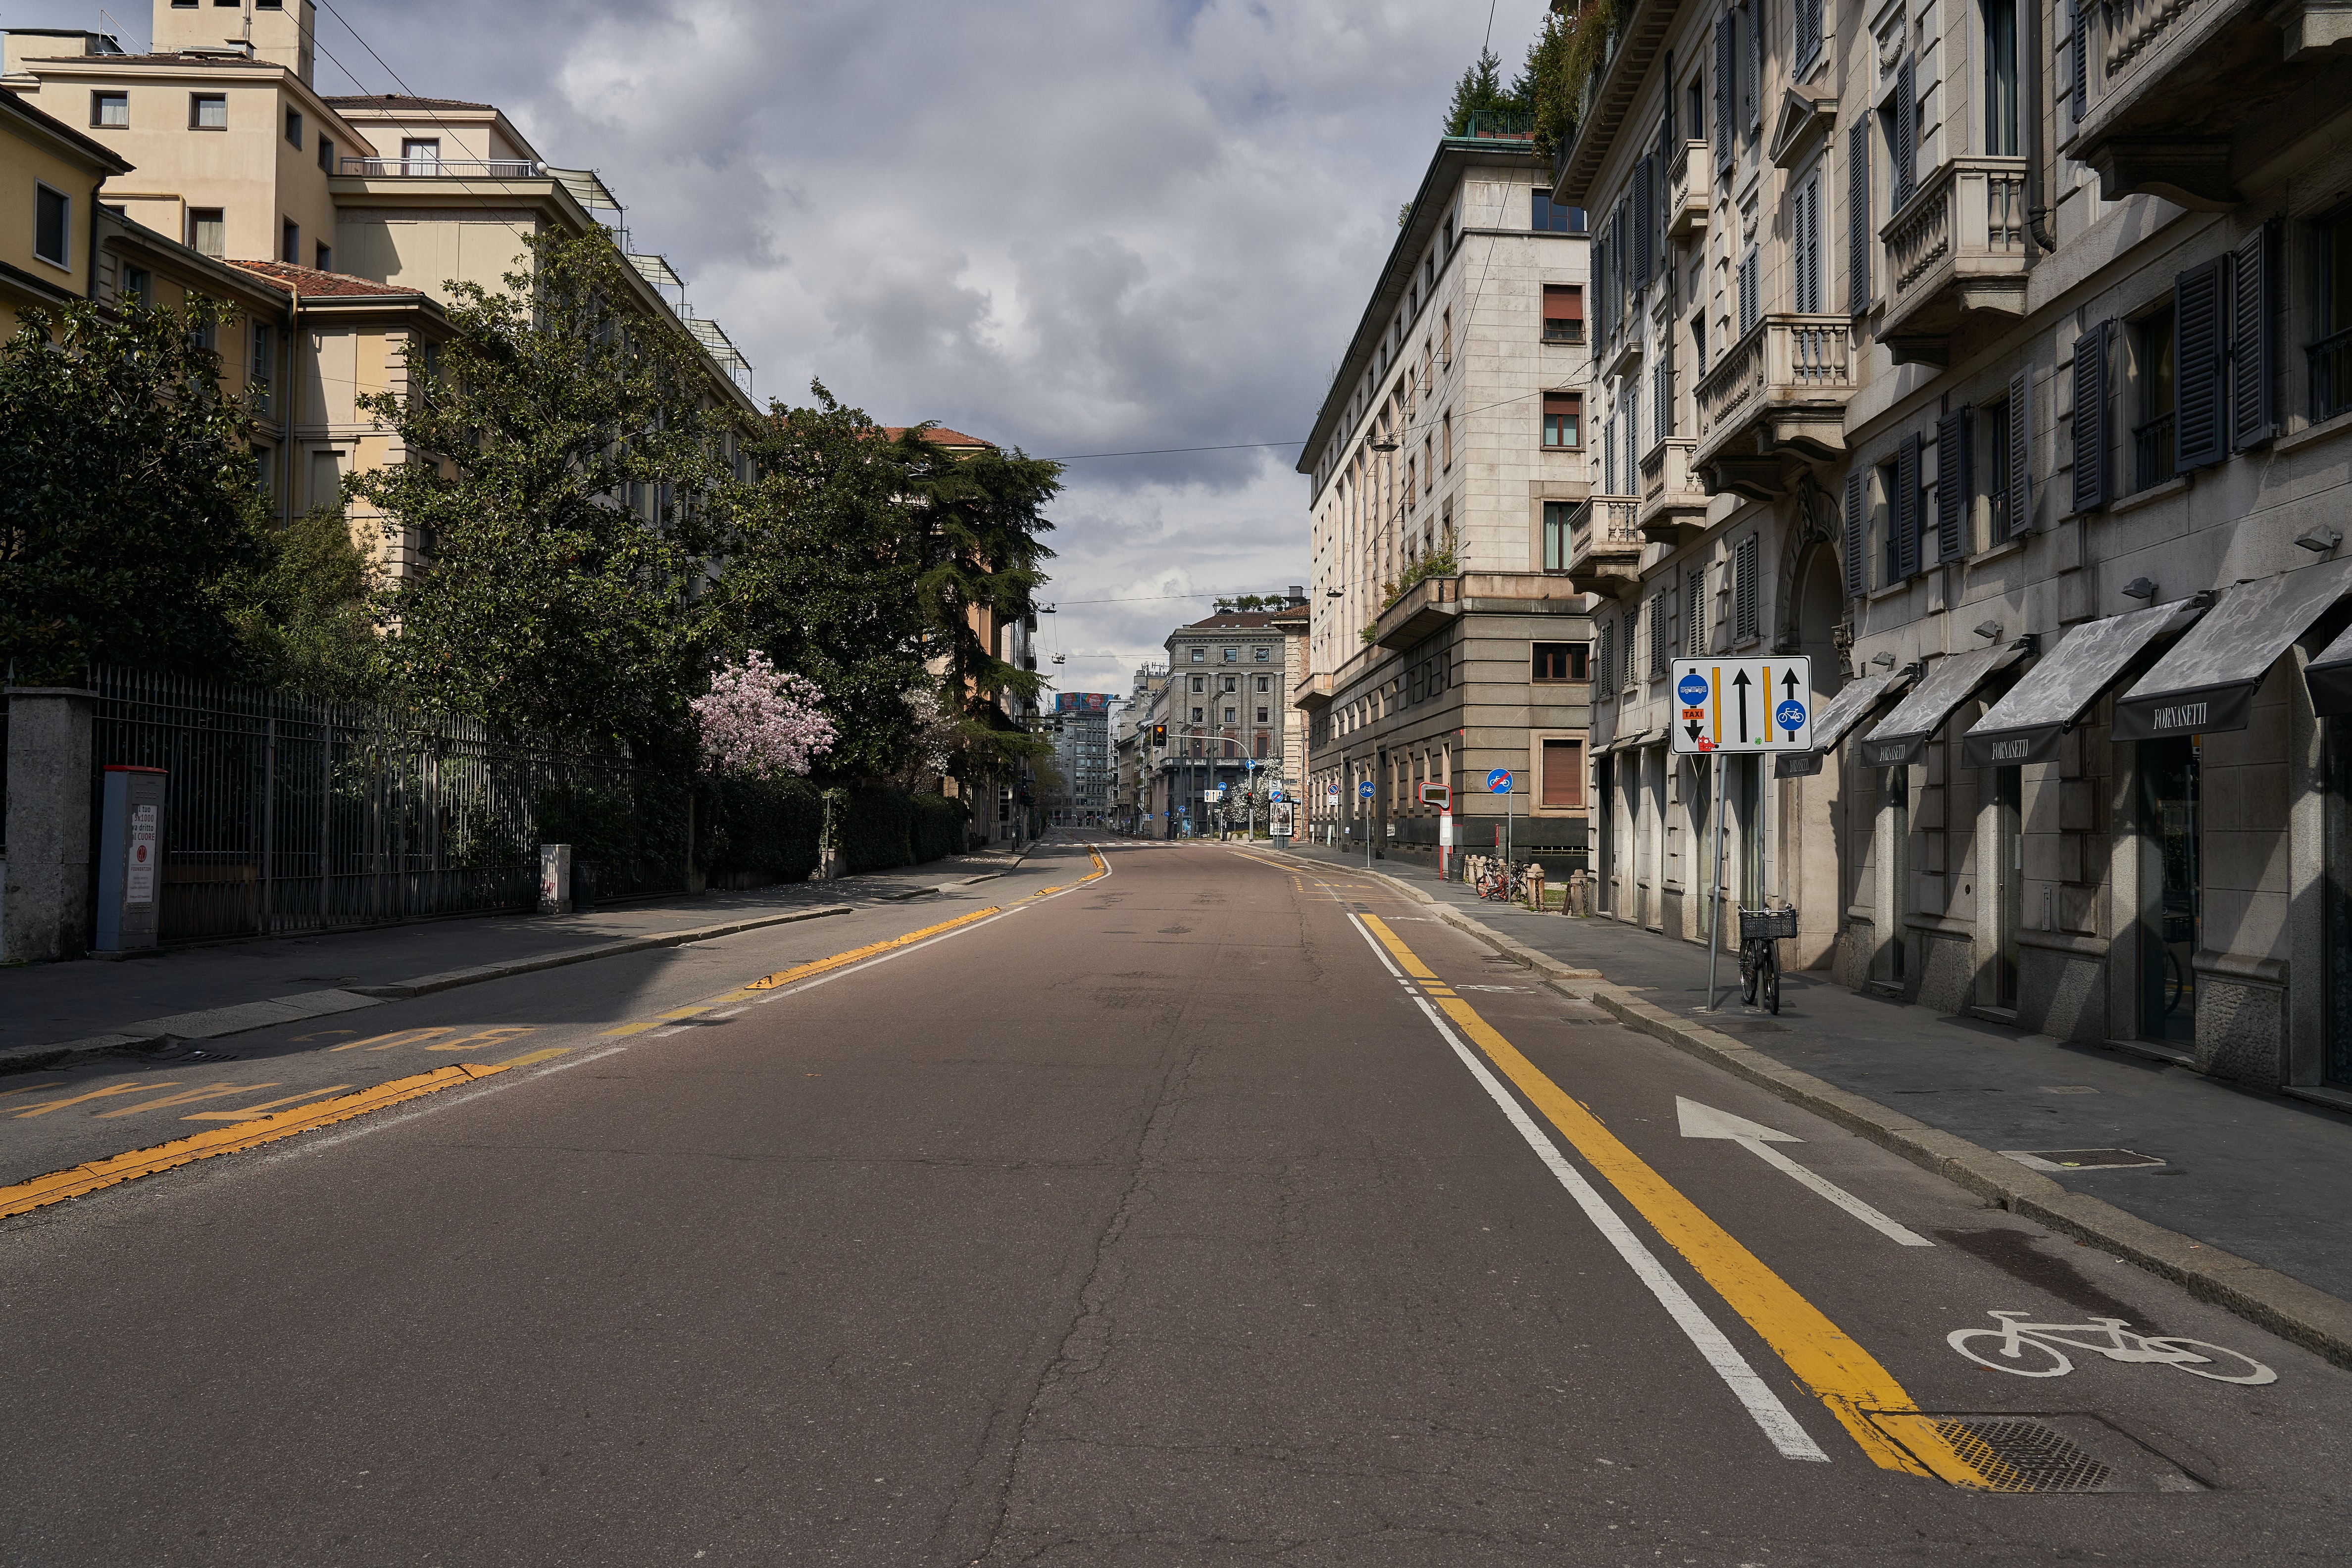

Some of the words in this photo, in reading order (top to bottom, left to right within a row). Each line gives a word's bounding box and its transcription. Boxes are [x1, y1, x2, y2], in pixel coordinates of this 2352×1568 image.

[2153, 702, 2207, 730] FORNASETTI
[1879, 744, 1905, 761] FORNASETTI
[1992, 739, 2029, 760] FORNASETTI
[135, 814, 153, 822] 5x1000
